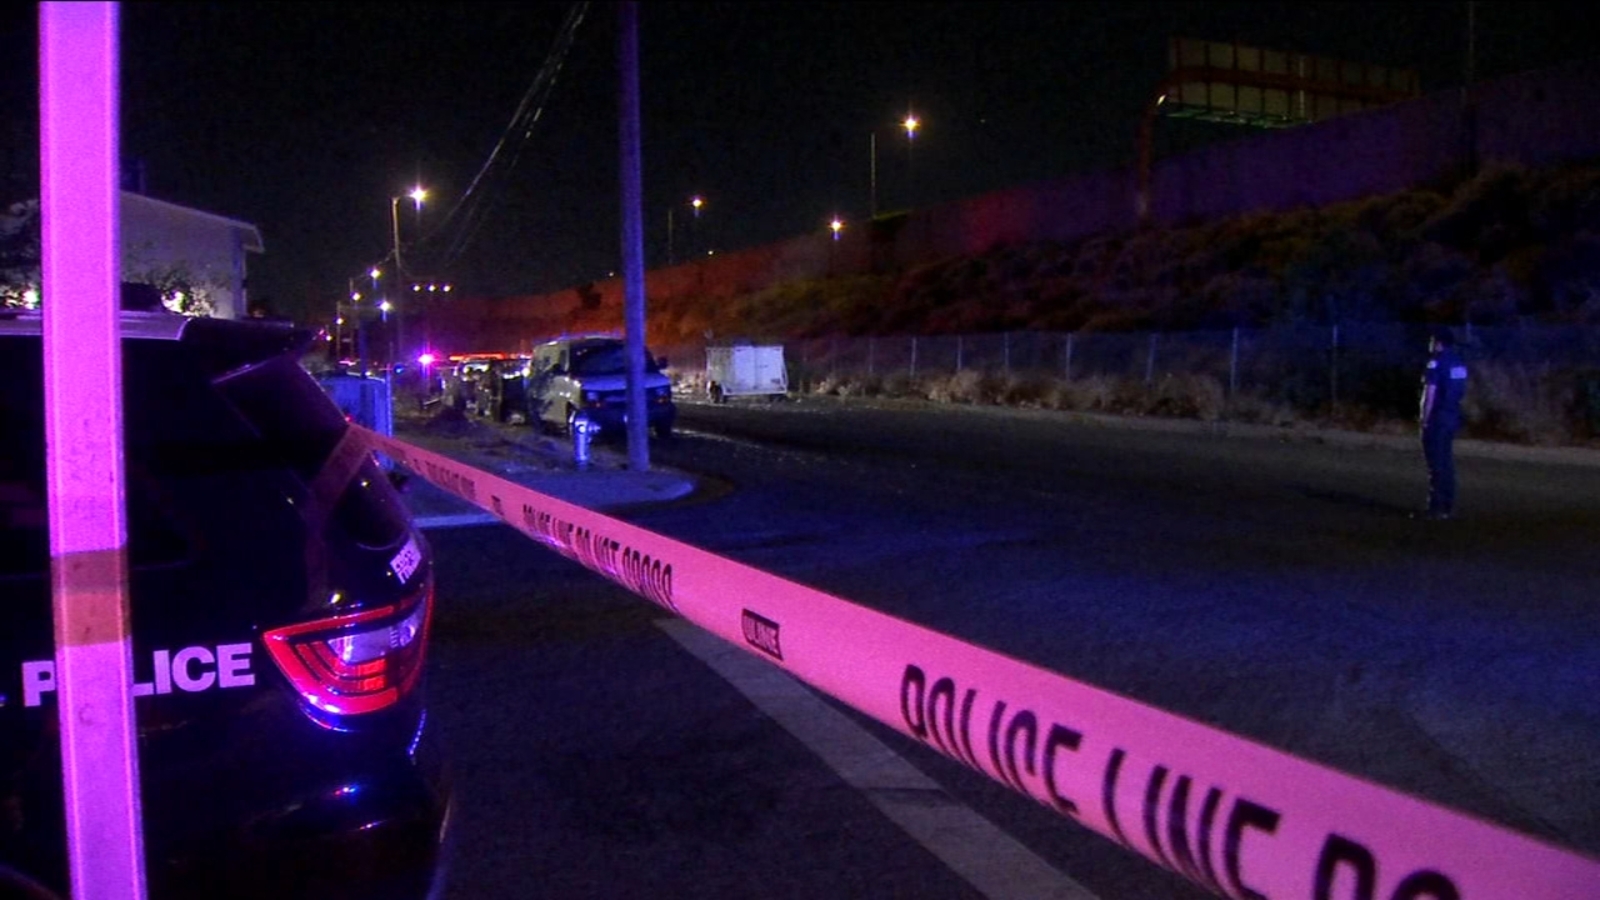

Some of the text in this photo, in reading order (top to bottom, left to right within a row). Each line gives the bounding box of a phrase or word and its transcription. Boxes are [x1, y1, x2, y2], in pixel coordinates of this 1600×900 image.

[22, 643, 256, 707] PICE
[902, 664, 1083, 815] POLICE
[1104, 748, 1282, 900] LINE
